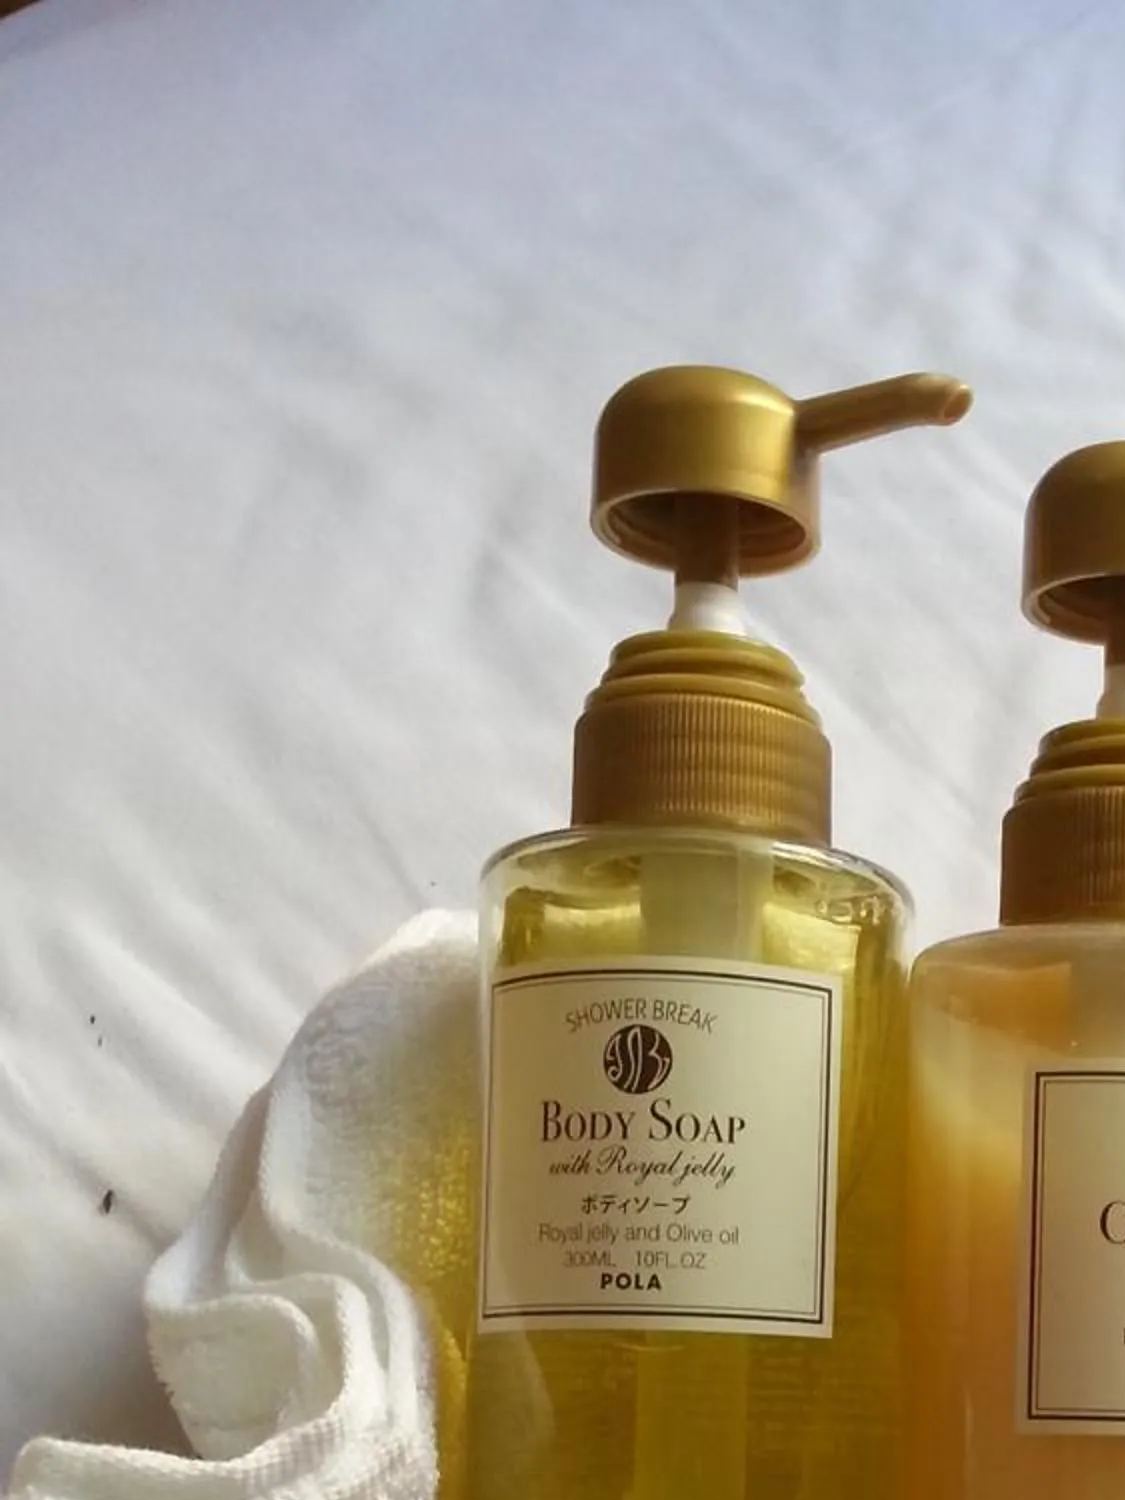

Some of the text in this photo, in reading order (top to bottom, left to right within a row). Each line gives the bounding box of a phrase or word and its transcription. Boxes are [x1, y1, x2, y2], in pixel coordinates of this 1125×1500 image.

[565, 998, 718, 1034] SHOWER BREAK
[541, 1099, 746, 1144] BODY SOAP
[549, 1145, 736, 1189] with Royal jelly
[538, 1223, 739, 1246] Royal jelly and Olive oil
[600, 1272, 662, 1291] POLA
